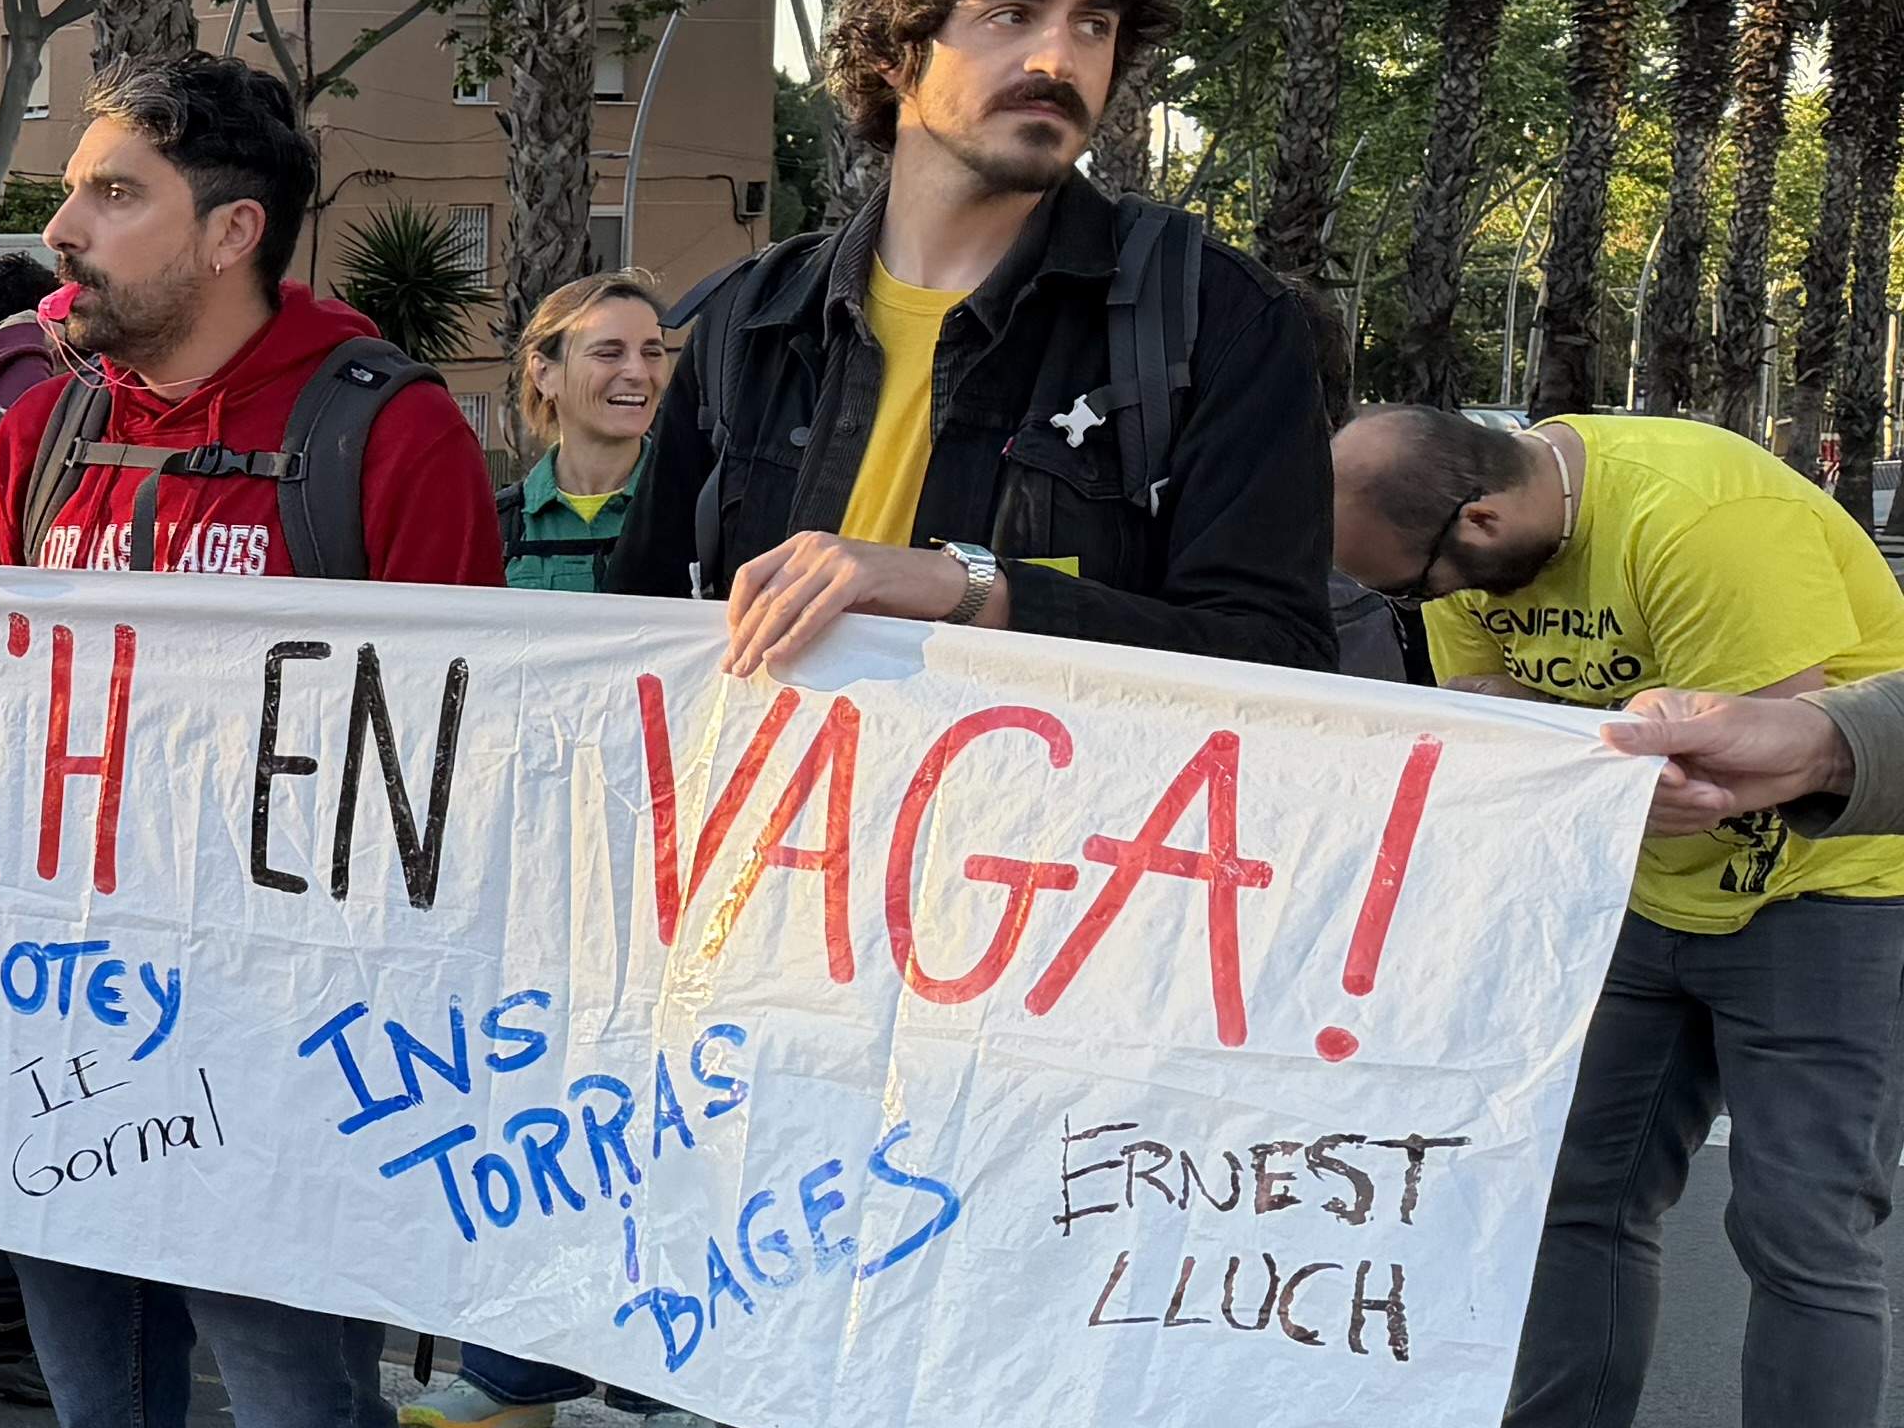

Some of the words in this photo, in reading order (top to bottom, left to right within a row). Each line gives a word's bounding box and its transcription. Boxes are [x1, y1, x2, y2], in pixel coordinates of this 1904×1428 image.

[250, 640, 470, 911] EN
[635, 671, 1443, 1063] VAGA!
[9, 1049, 133, 1118] IE
[298, 988, 552, 1135] INS
[12, 1067, 224, 1197] Gornal
[379, 1023, 749, 1243] TORRAS
[1052, 1113, 1472, 1237] ERNEST
[613, 1119, 961, 1373] BAGES
[1088, 1251, 1409, 1362] LLUCH
